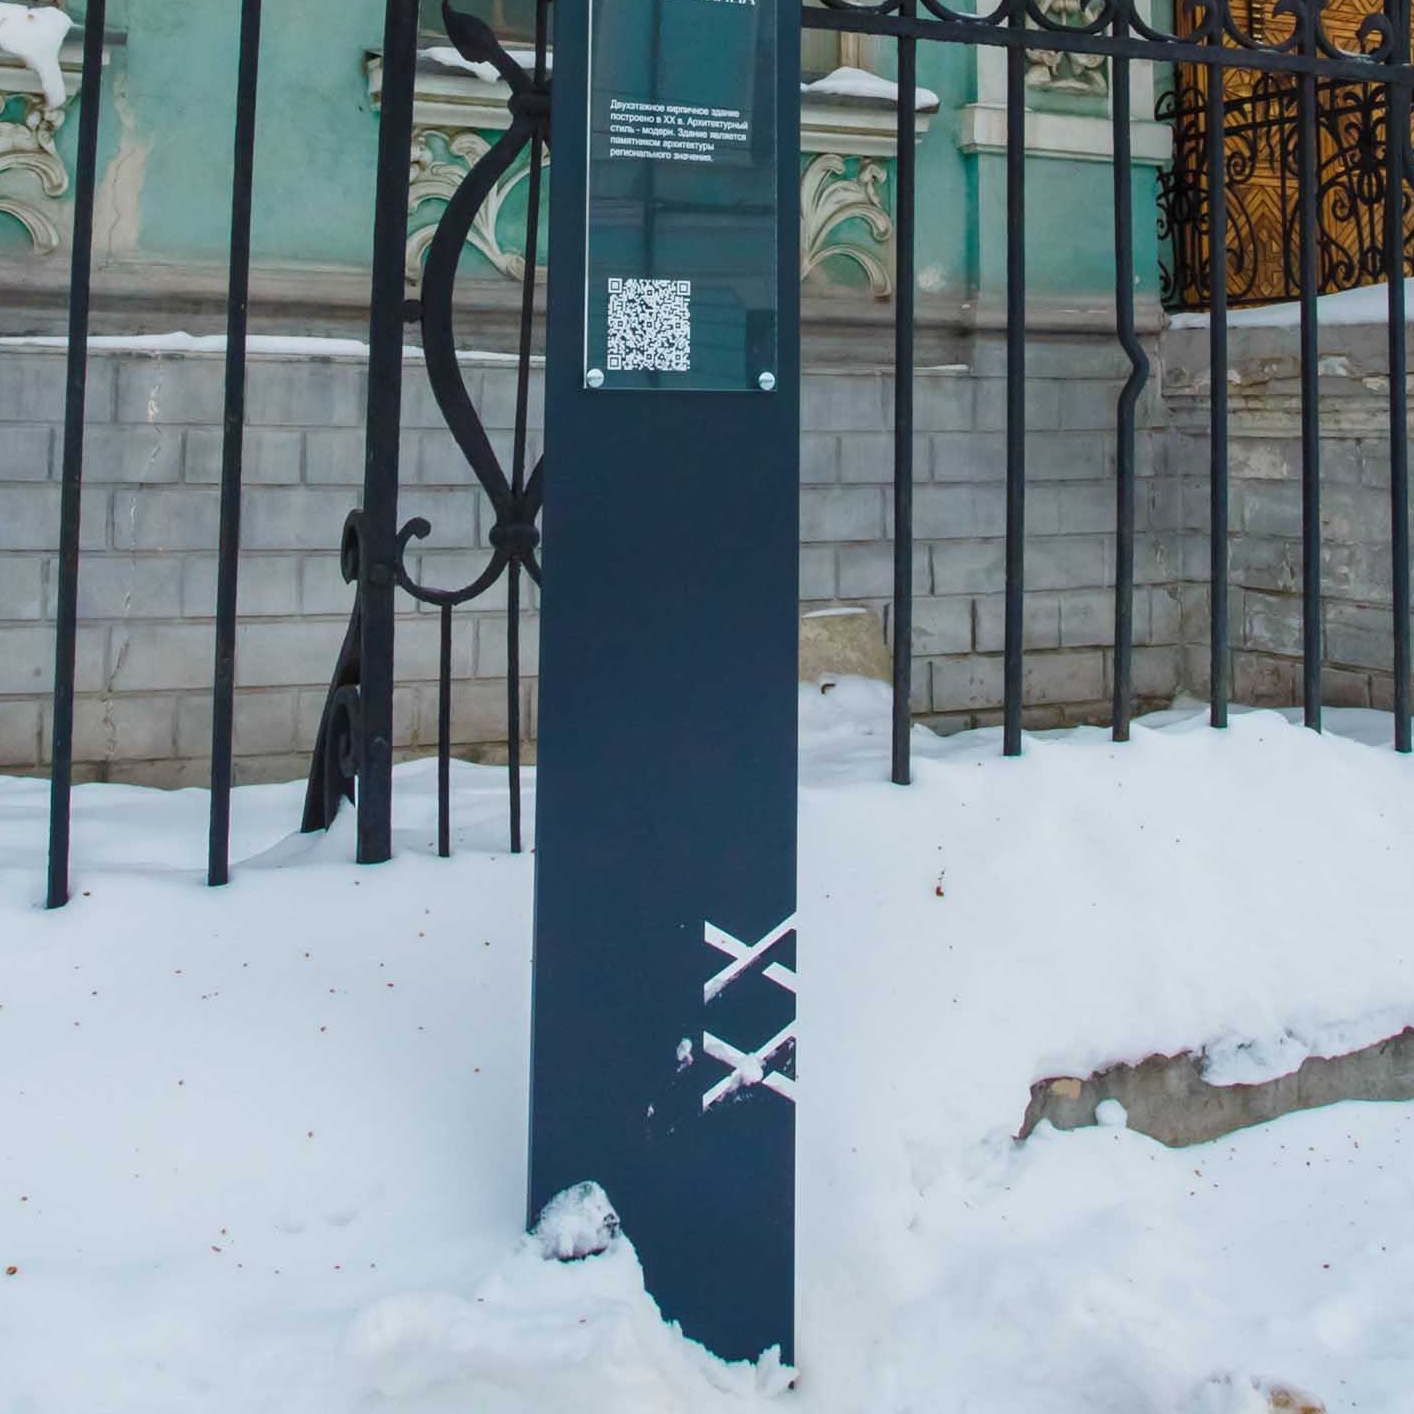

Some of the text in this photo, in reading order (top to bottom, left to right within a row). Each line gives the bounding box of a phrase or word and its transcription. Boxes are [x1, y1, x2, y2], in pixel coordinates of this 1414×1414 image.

[610, 99, 740, 119] Двухэтажное кирпичное здание
[610, 113, 655, 124] построено
[687, 117, 748, 130] Архитектурный
[610, 125, 634, 134] стиль
[677, 129, 708, 139] Здание
[709, 133, 747, 141] является
[610, 136, 715, 151] памятником архитектуры
[610, 148, 714, 162] регионального значения.
